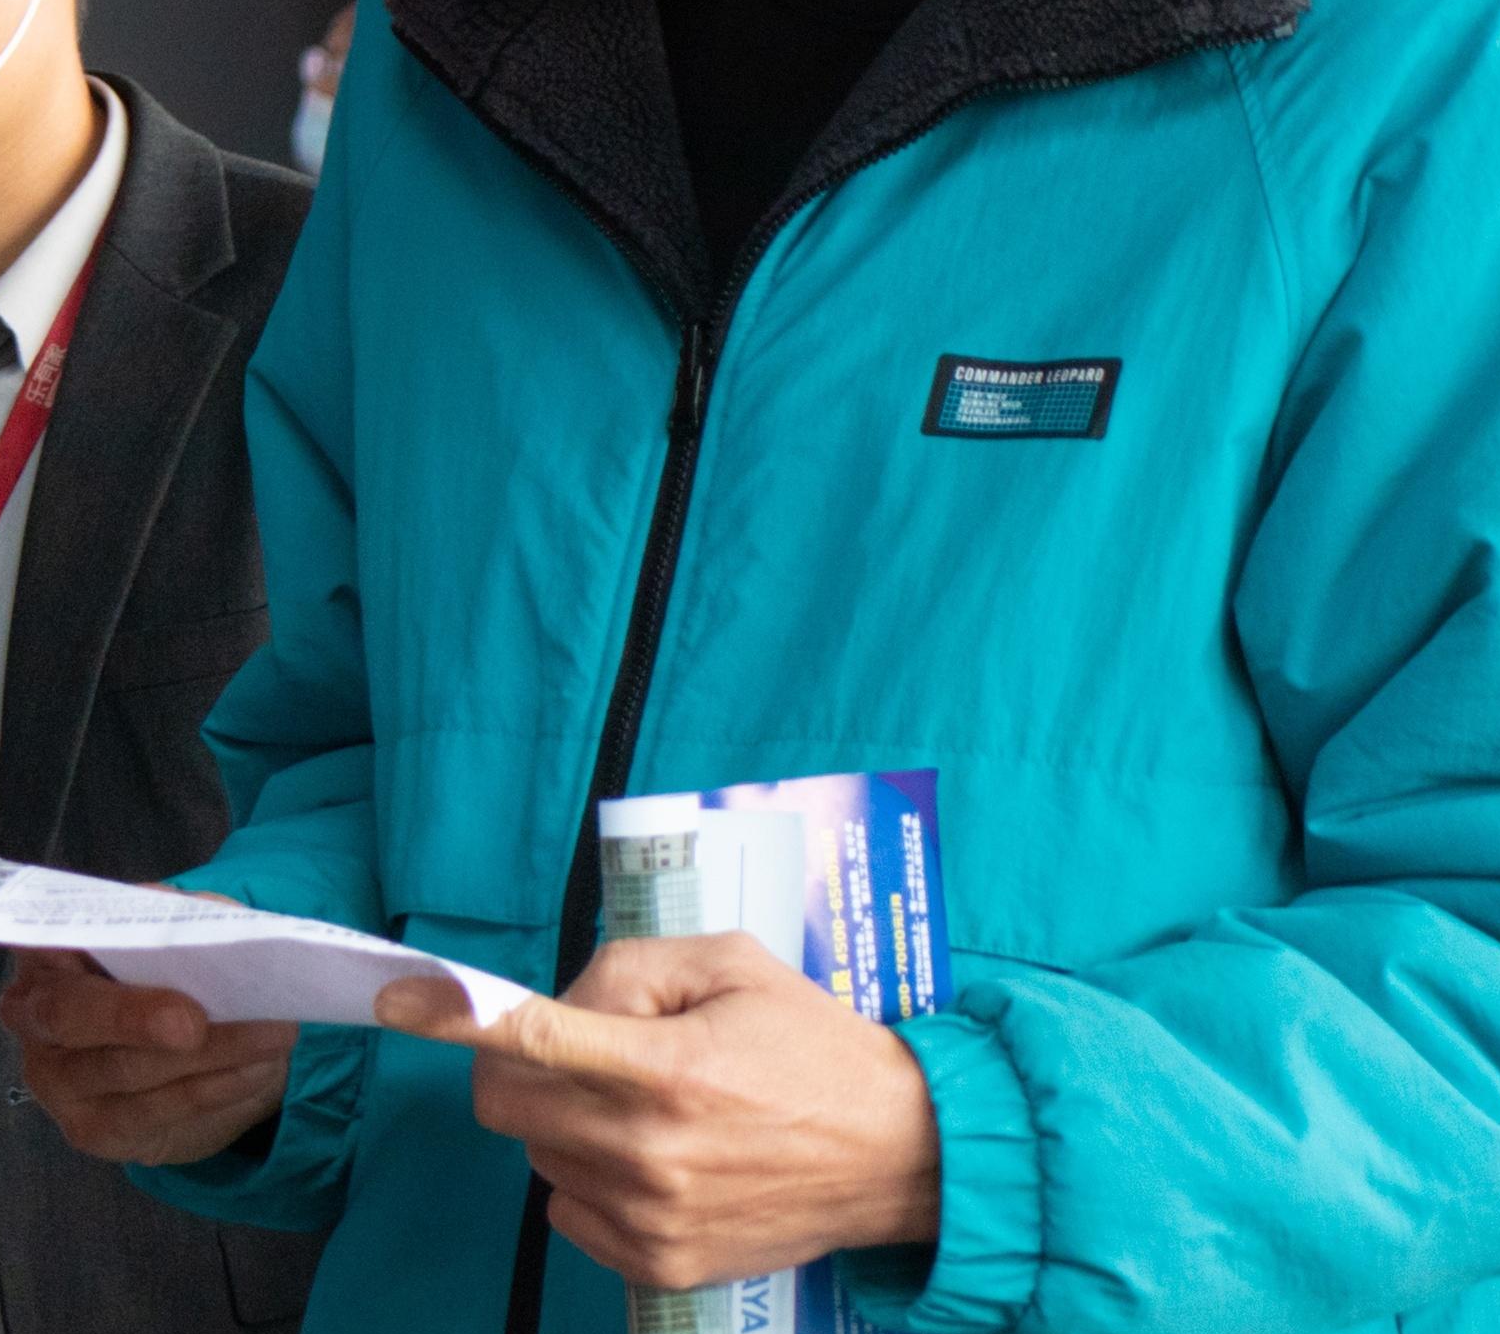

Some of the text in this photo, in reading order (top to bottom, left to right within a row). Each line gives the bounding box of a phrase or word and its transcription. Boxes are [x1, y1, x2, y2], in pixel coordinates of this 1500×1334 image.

[25, 343, 66, 405] 乐有家
[953, 365, 1105, 385] COMMANDER LEOPARD
[889, 892, 914, 1020] 000-7000元/月
